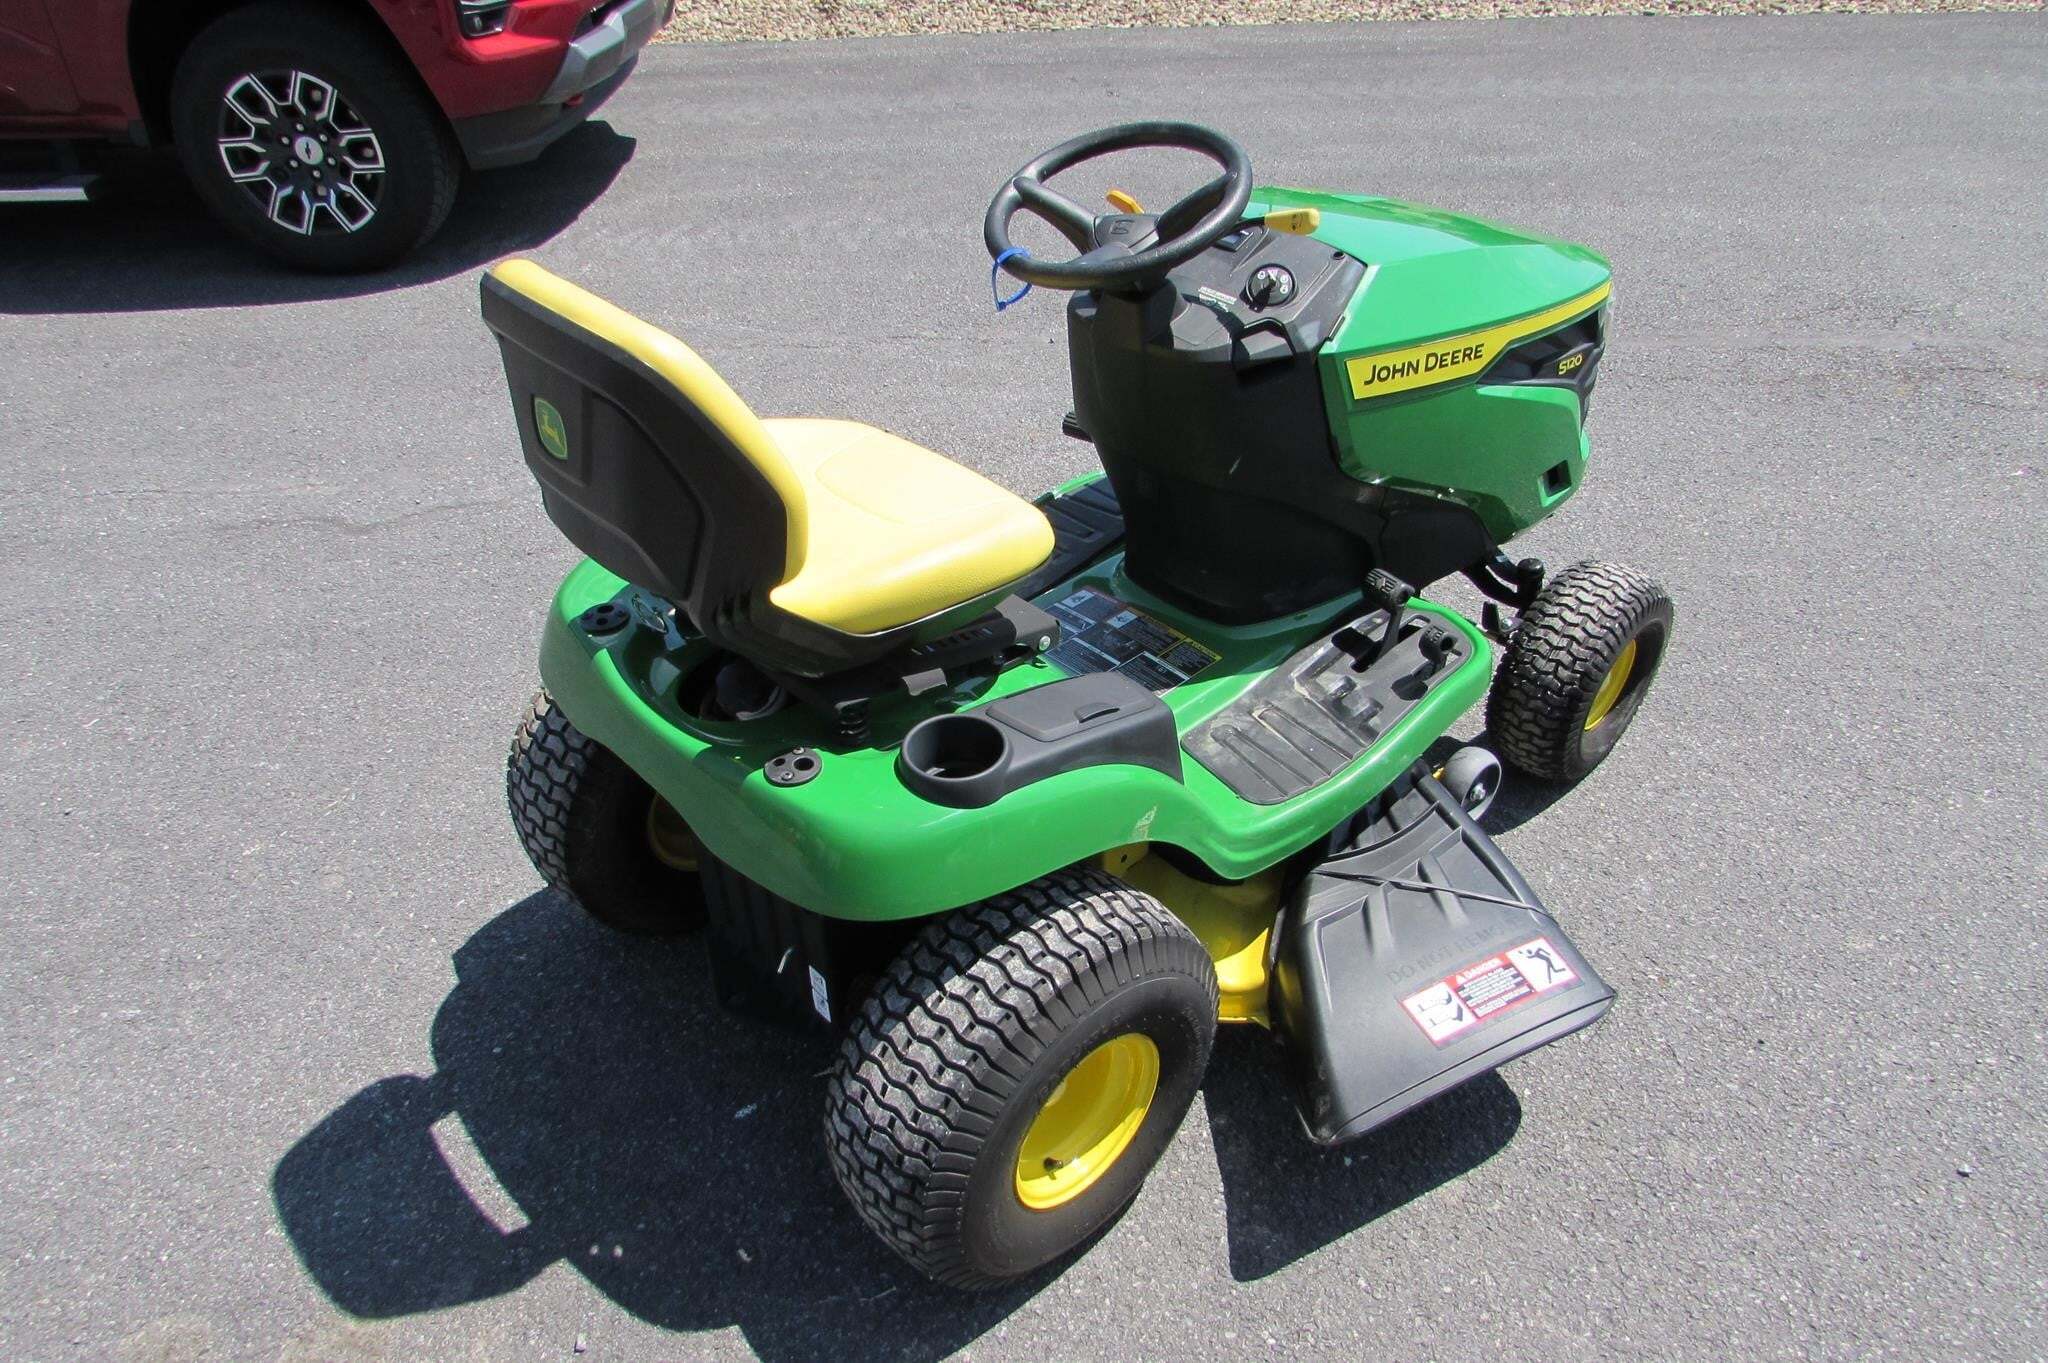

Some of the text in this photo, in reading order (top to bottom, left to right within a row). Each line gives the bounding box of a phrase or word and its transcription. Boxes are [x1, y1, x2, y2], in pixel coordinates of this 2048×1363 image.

[1364, 343, 1485, 386] JOHN DEERE
[1558, 353, 1583, 376] S120
